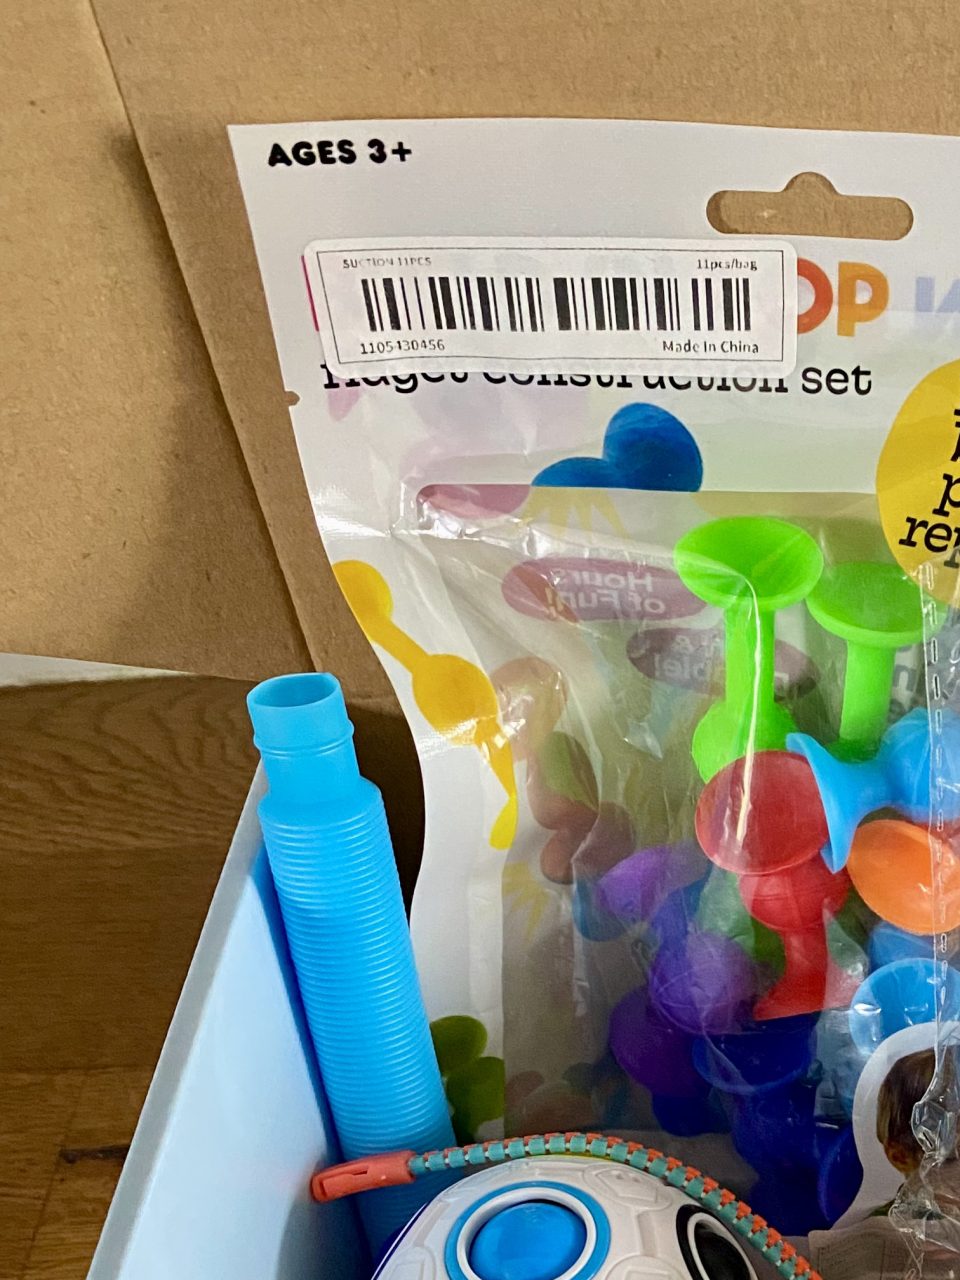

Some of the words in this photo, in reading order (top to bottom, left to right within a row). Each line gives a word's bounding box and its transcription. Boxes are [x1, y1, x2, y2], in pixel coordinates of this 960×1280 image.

[268, 139, 357, 167] AGES
[367, 138, 412, 164] 3+
[359, 339, 446, 355] 1105430456
[662, 340, 700, 353] Made
[703, 340, 717, 353] In
[720, 340, 760, 354] China
[801, 364, 873, 396] set
